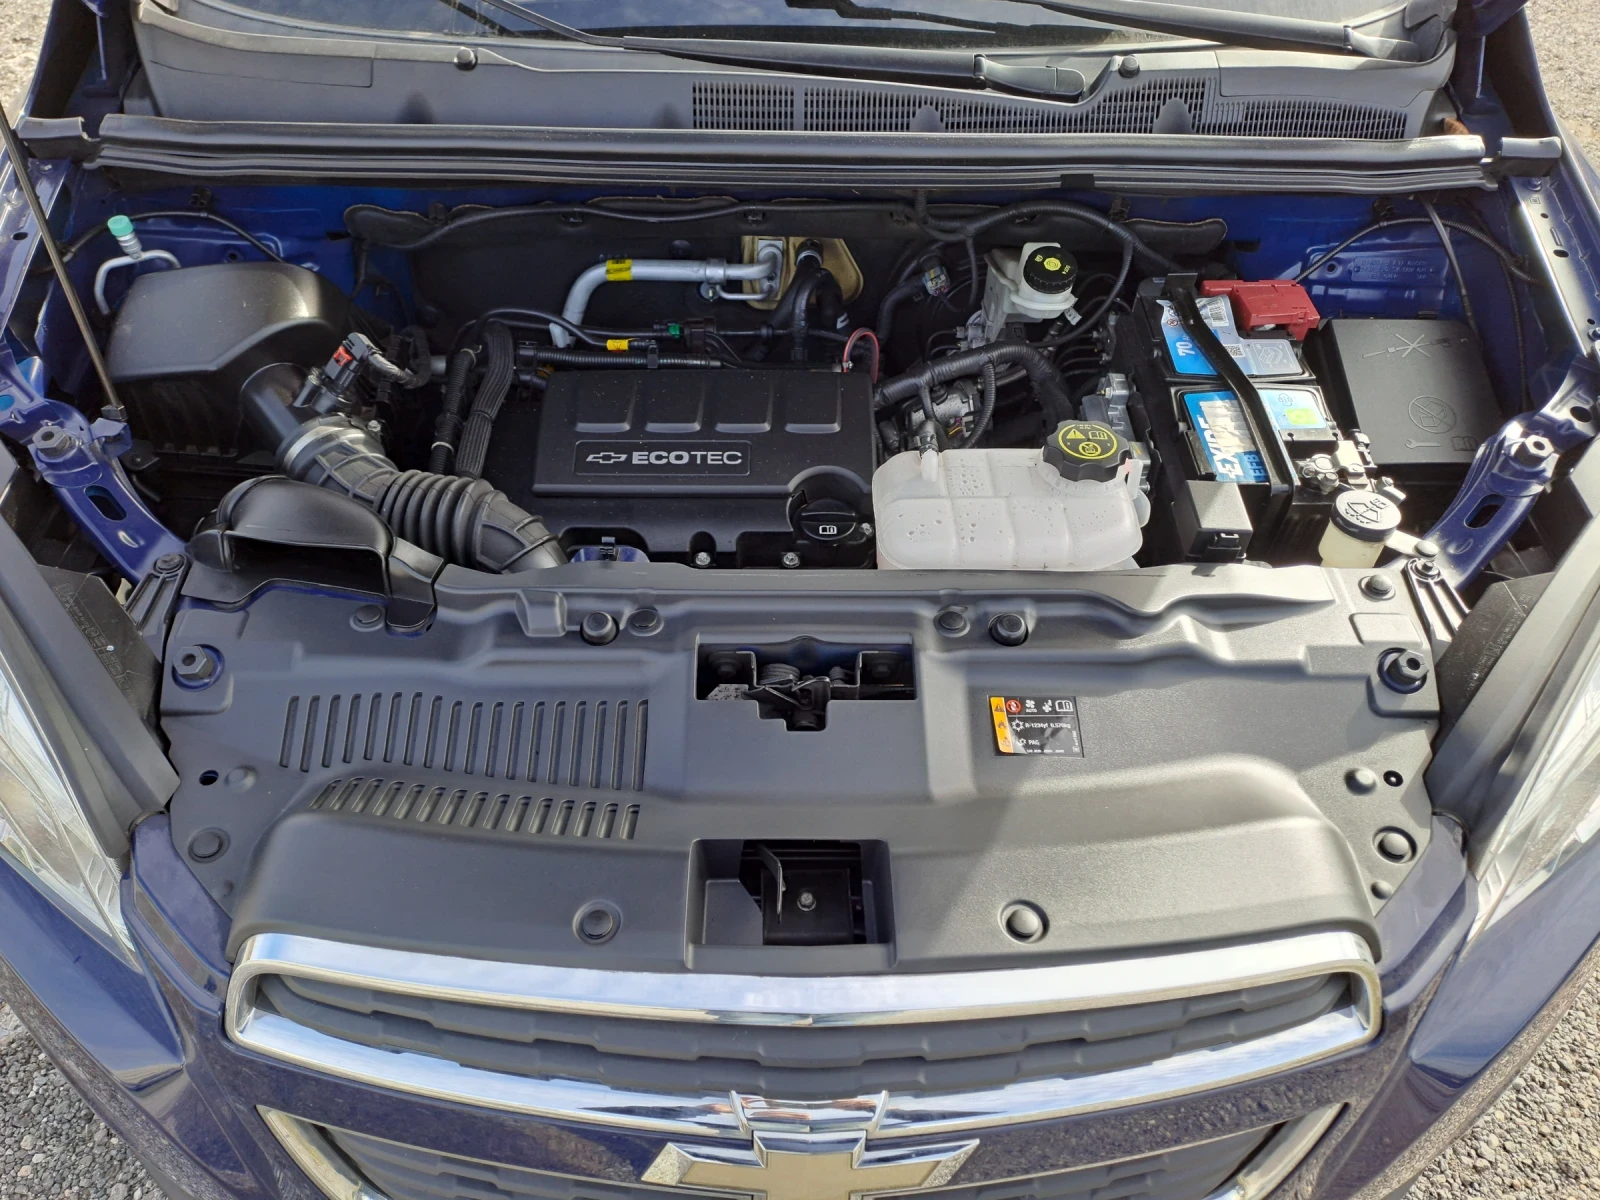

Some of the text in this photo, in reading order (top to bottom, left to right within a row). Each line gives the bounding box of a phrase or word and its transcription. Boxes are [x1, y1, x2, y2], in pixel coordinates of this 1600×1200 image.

[1175, 341, 1195, 356] 70
[631, 451, 743, 465] ECOTEC
[1245, 454, 1265, 478] EFB
